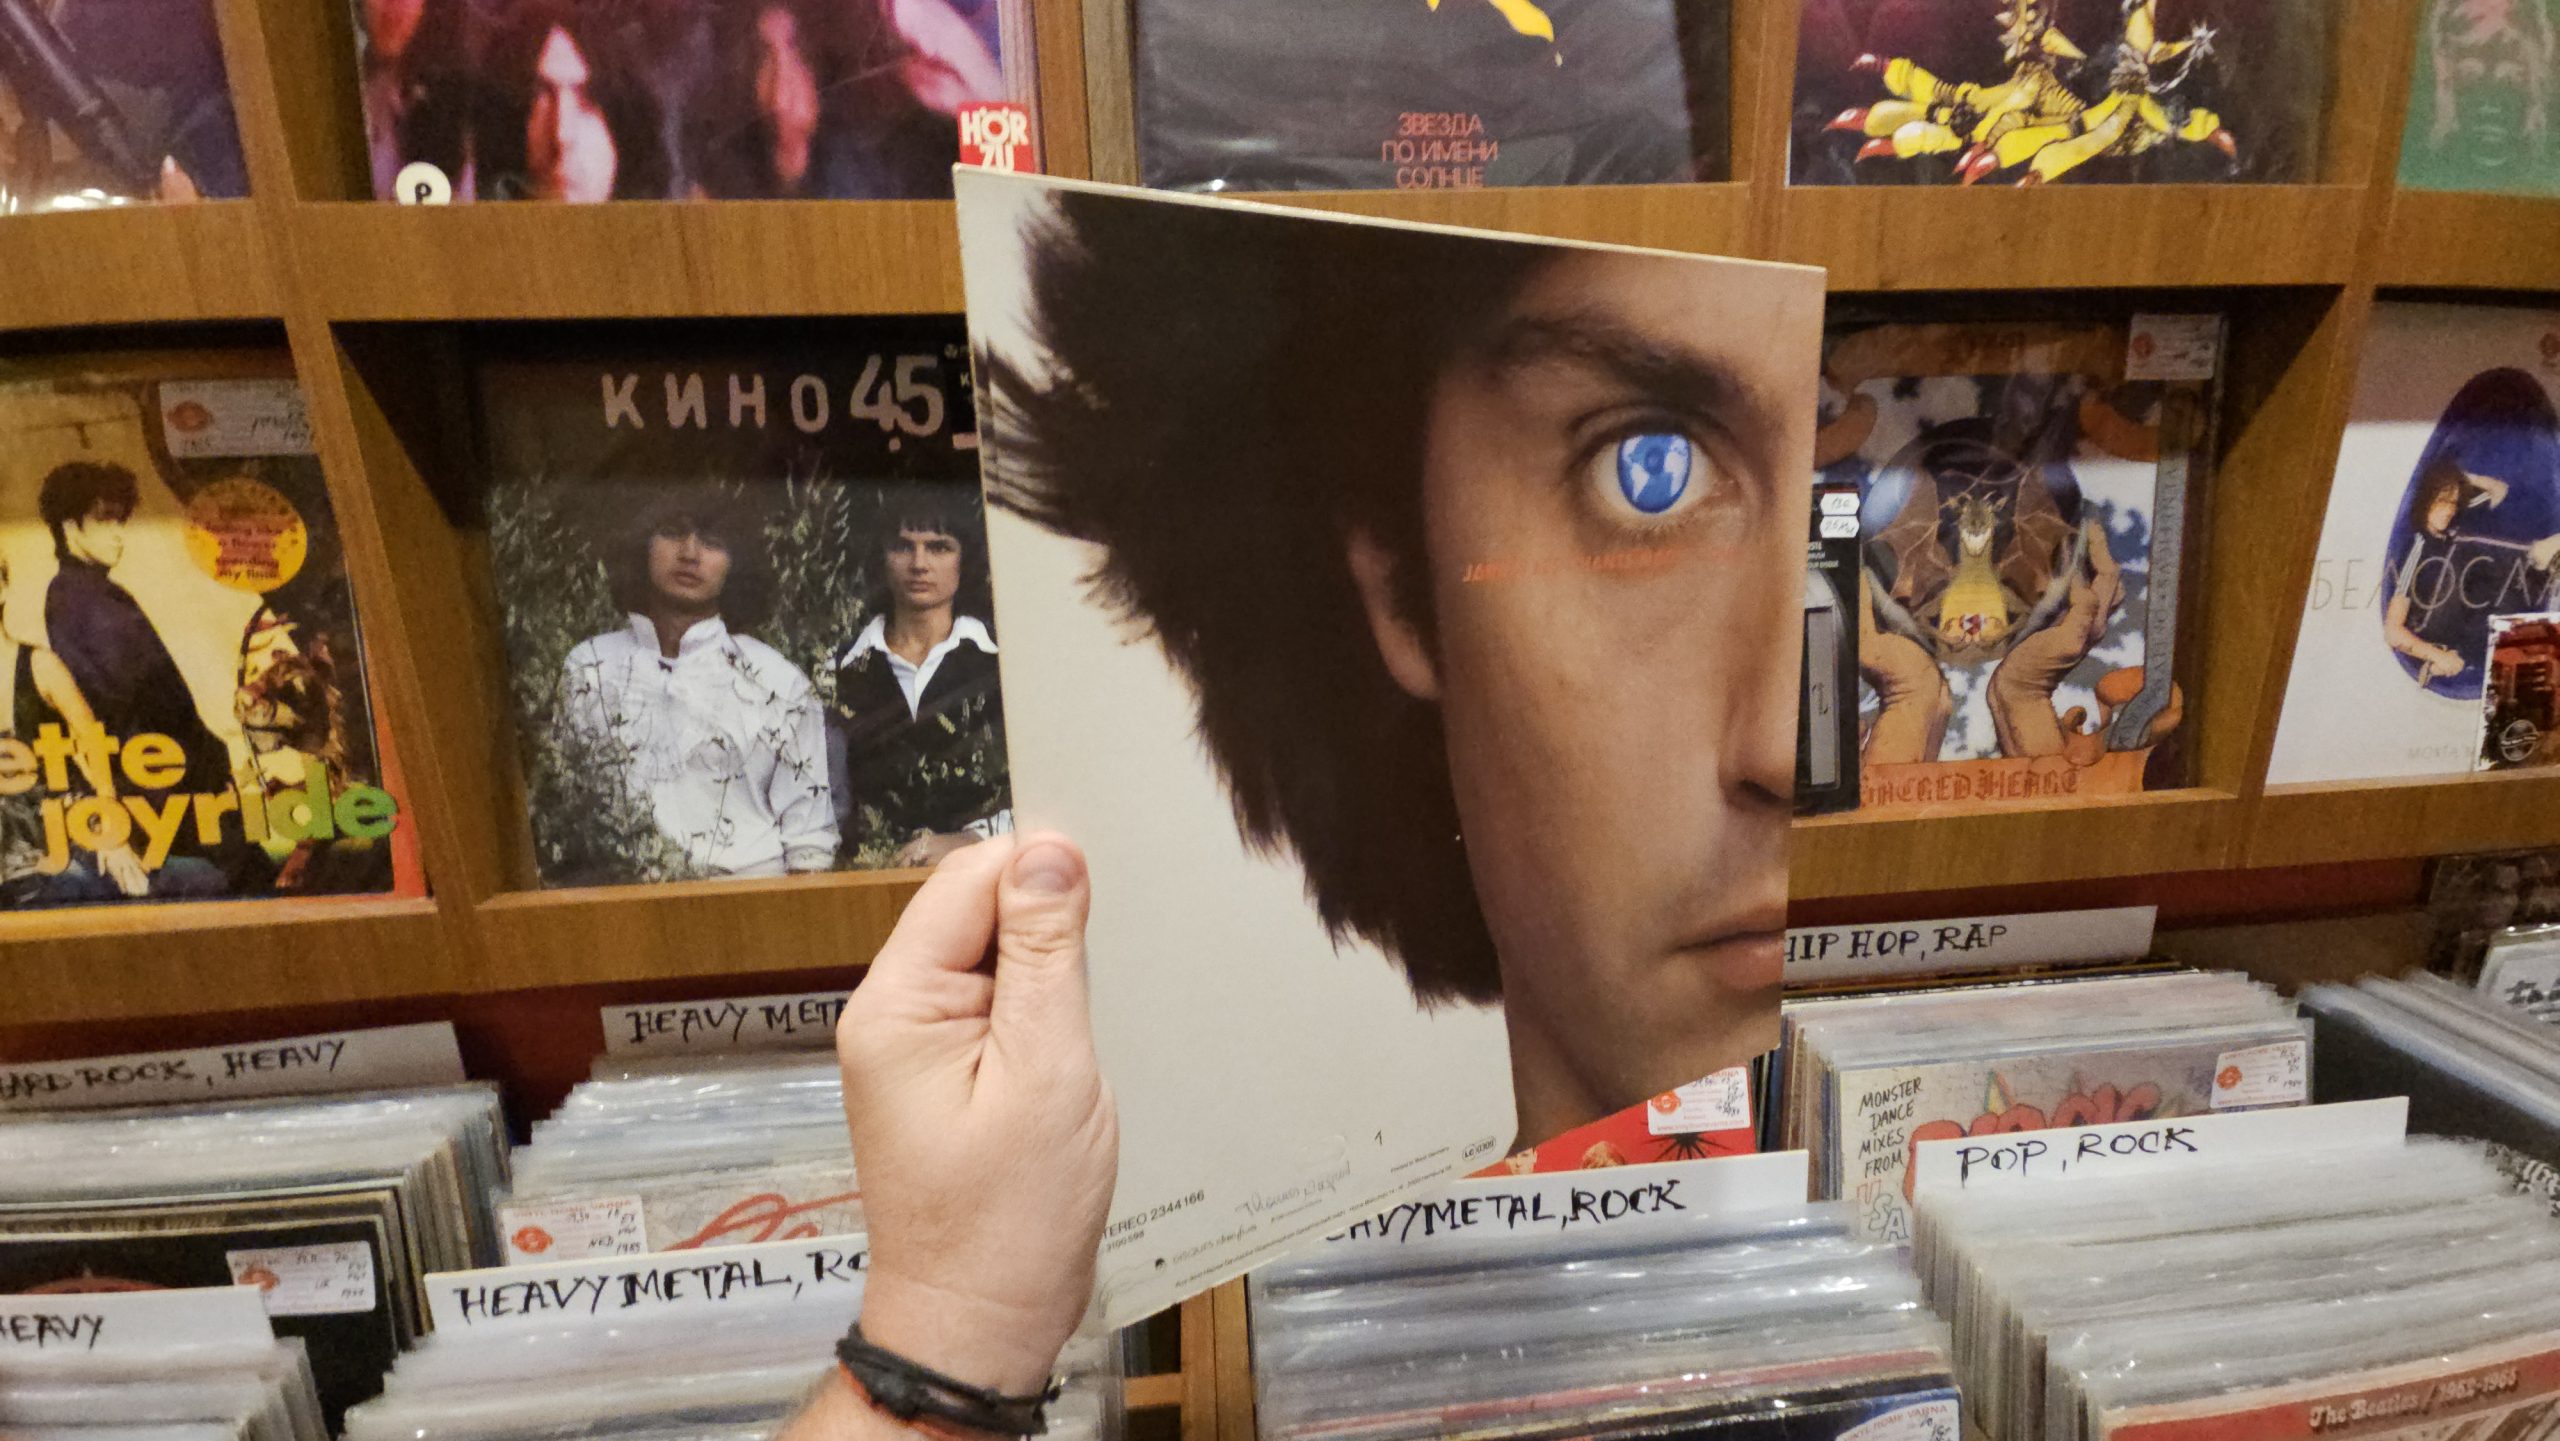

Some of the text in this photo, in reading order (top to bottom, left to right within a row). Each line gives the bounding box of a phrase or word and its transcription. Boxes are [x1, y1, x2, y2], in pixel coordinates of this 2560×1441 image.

[1398, 111, 1485, 137] ЗВЕЗДА
[1381, 139, 1499, 163] ПО ИМЕНИ
[1395, 166, 1485, 189] СОЛНЦЕ
[601, 372, 830, 434] КИНО
[38, 754, 399, 877] joyride
[1933, 923, 2008, 952] RAP
[625, 1002, 749, 1044] HEAVY
[0, 1071, 73, 1098] ARD
[222, 1039, 345, 1081] HEAVY
[1858, 1076, 1924, 1117] MONSTER
[1869, 1101, 1915, 1132] DANCE
[1864, 1149, 1906, 1178] FROM
[2076, 1127, 2199, 1164] ROCK
[1570, 1179, 1688, 1223] ROCK
[453, 1275, 608, 1325] HEAVY
[2309, 1406, 2347, 1428] The
[2350, 1394, 2420, 1420] Beatles
